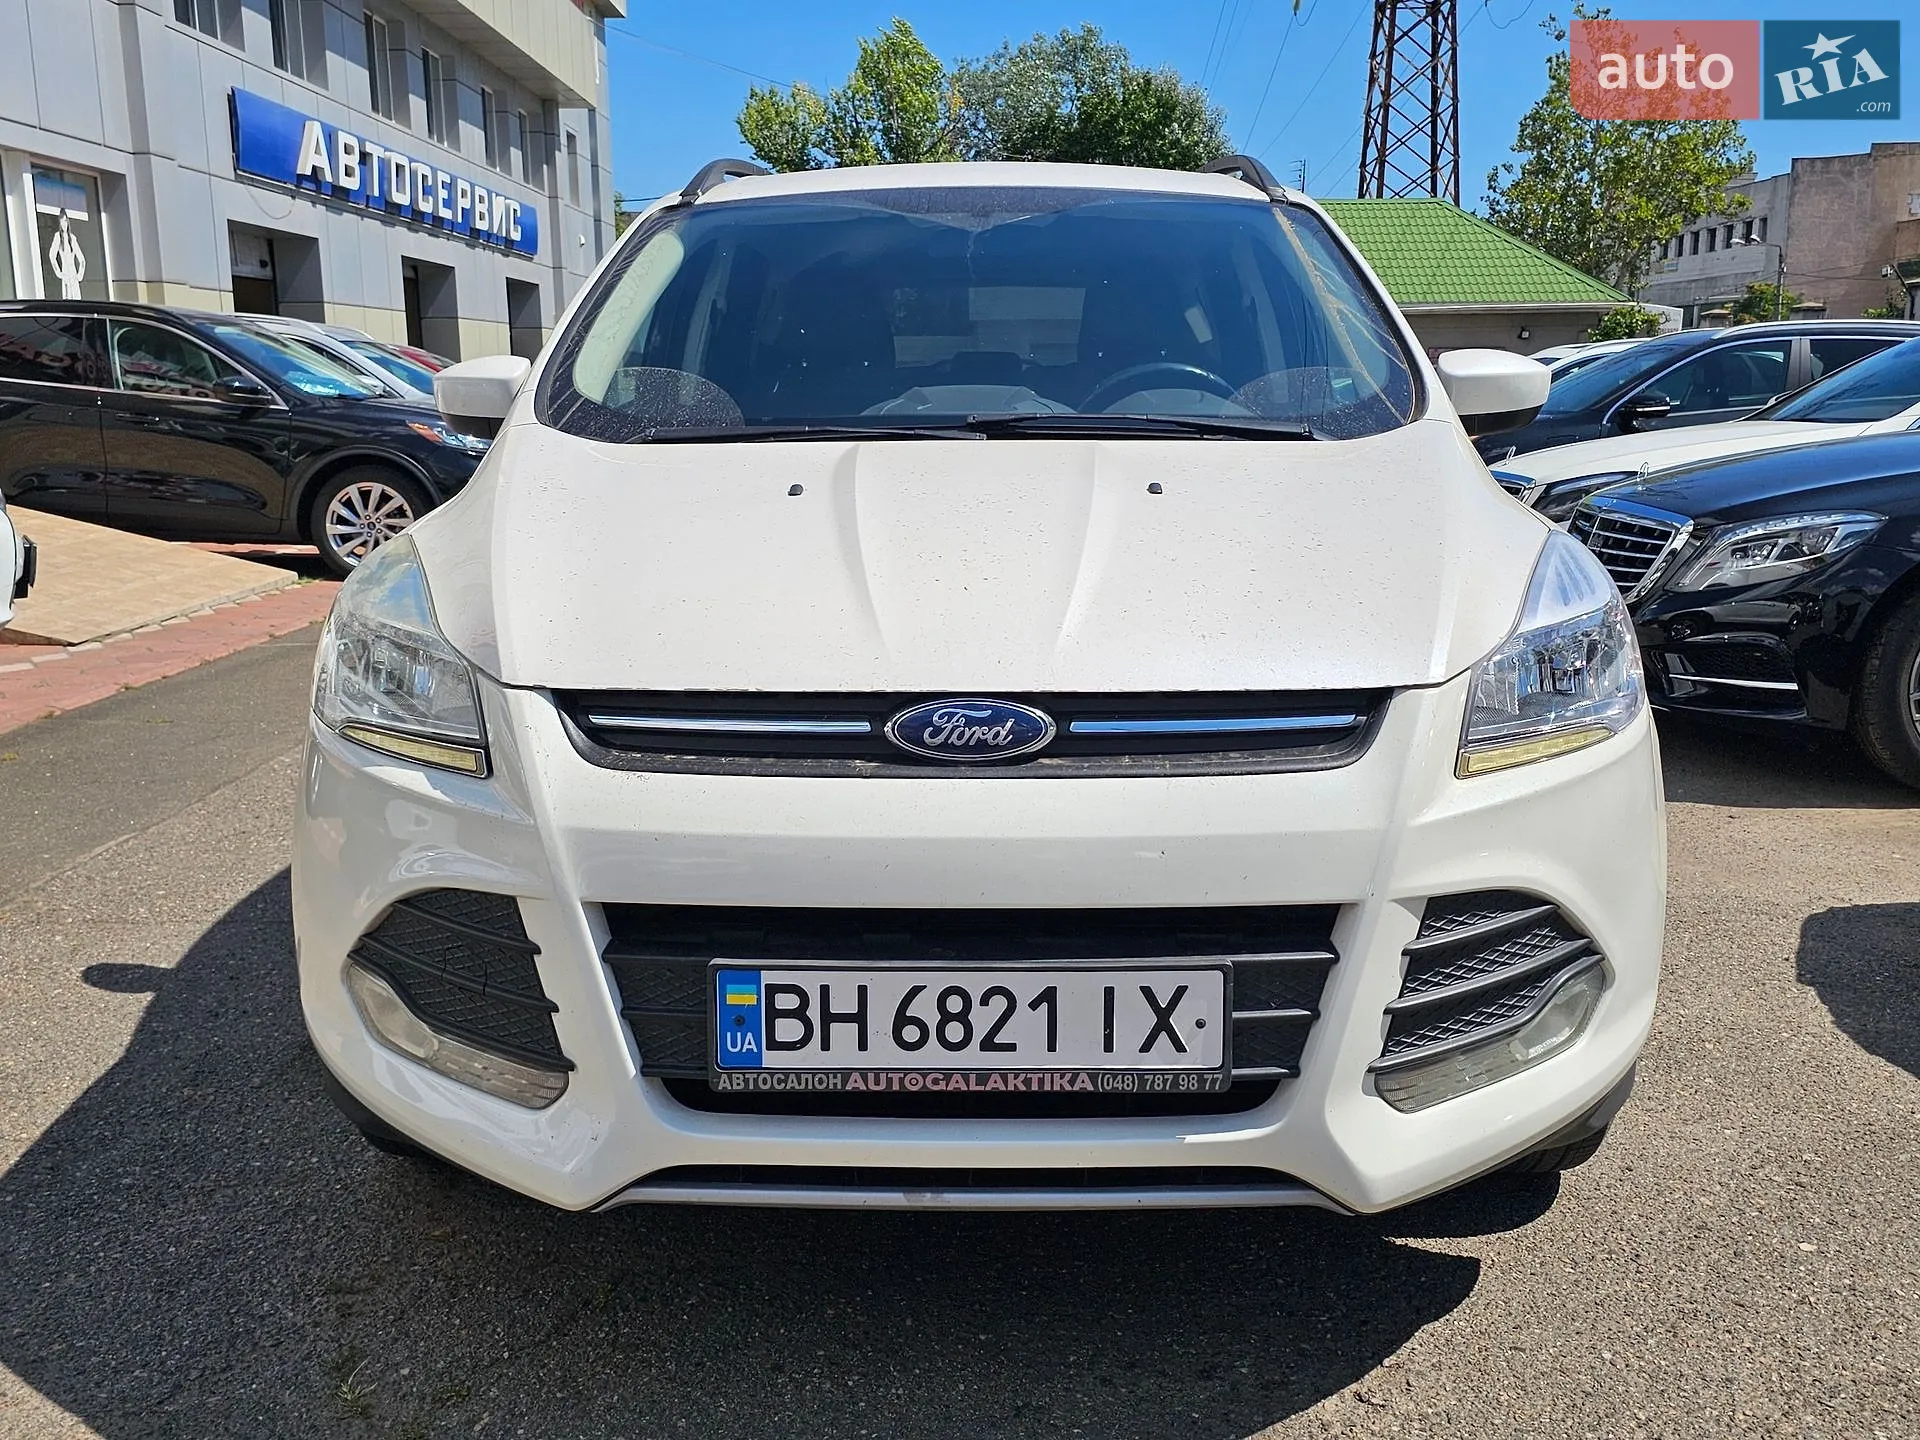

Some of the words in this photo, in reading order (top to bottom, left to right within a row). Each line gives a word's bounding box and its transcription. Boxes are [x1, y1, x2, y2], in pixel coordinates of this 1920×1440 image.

[296, 120, 522, 242] АВТОСЕРВИС
[923, 708, 1016, 747] Ford
[764, 983, 869, 1052] BH
[892, 984, 1058, 1053] 6821
[1103, 984, 1189, 1054] IX
[726, 1031, 758, 1053] UA
[717, 1073, 843, 1091] АВТОСАЛОН
[845, 1072, 1095, 1092] AUTOGALAKTIKA
[1097, 1073, 1138, 1093] (048)
[1144, 1074, 1173, 1092] 787
[1179, 1074, 1199, 1092] 98
[1203, 1074, 1224, 1092] 77
